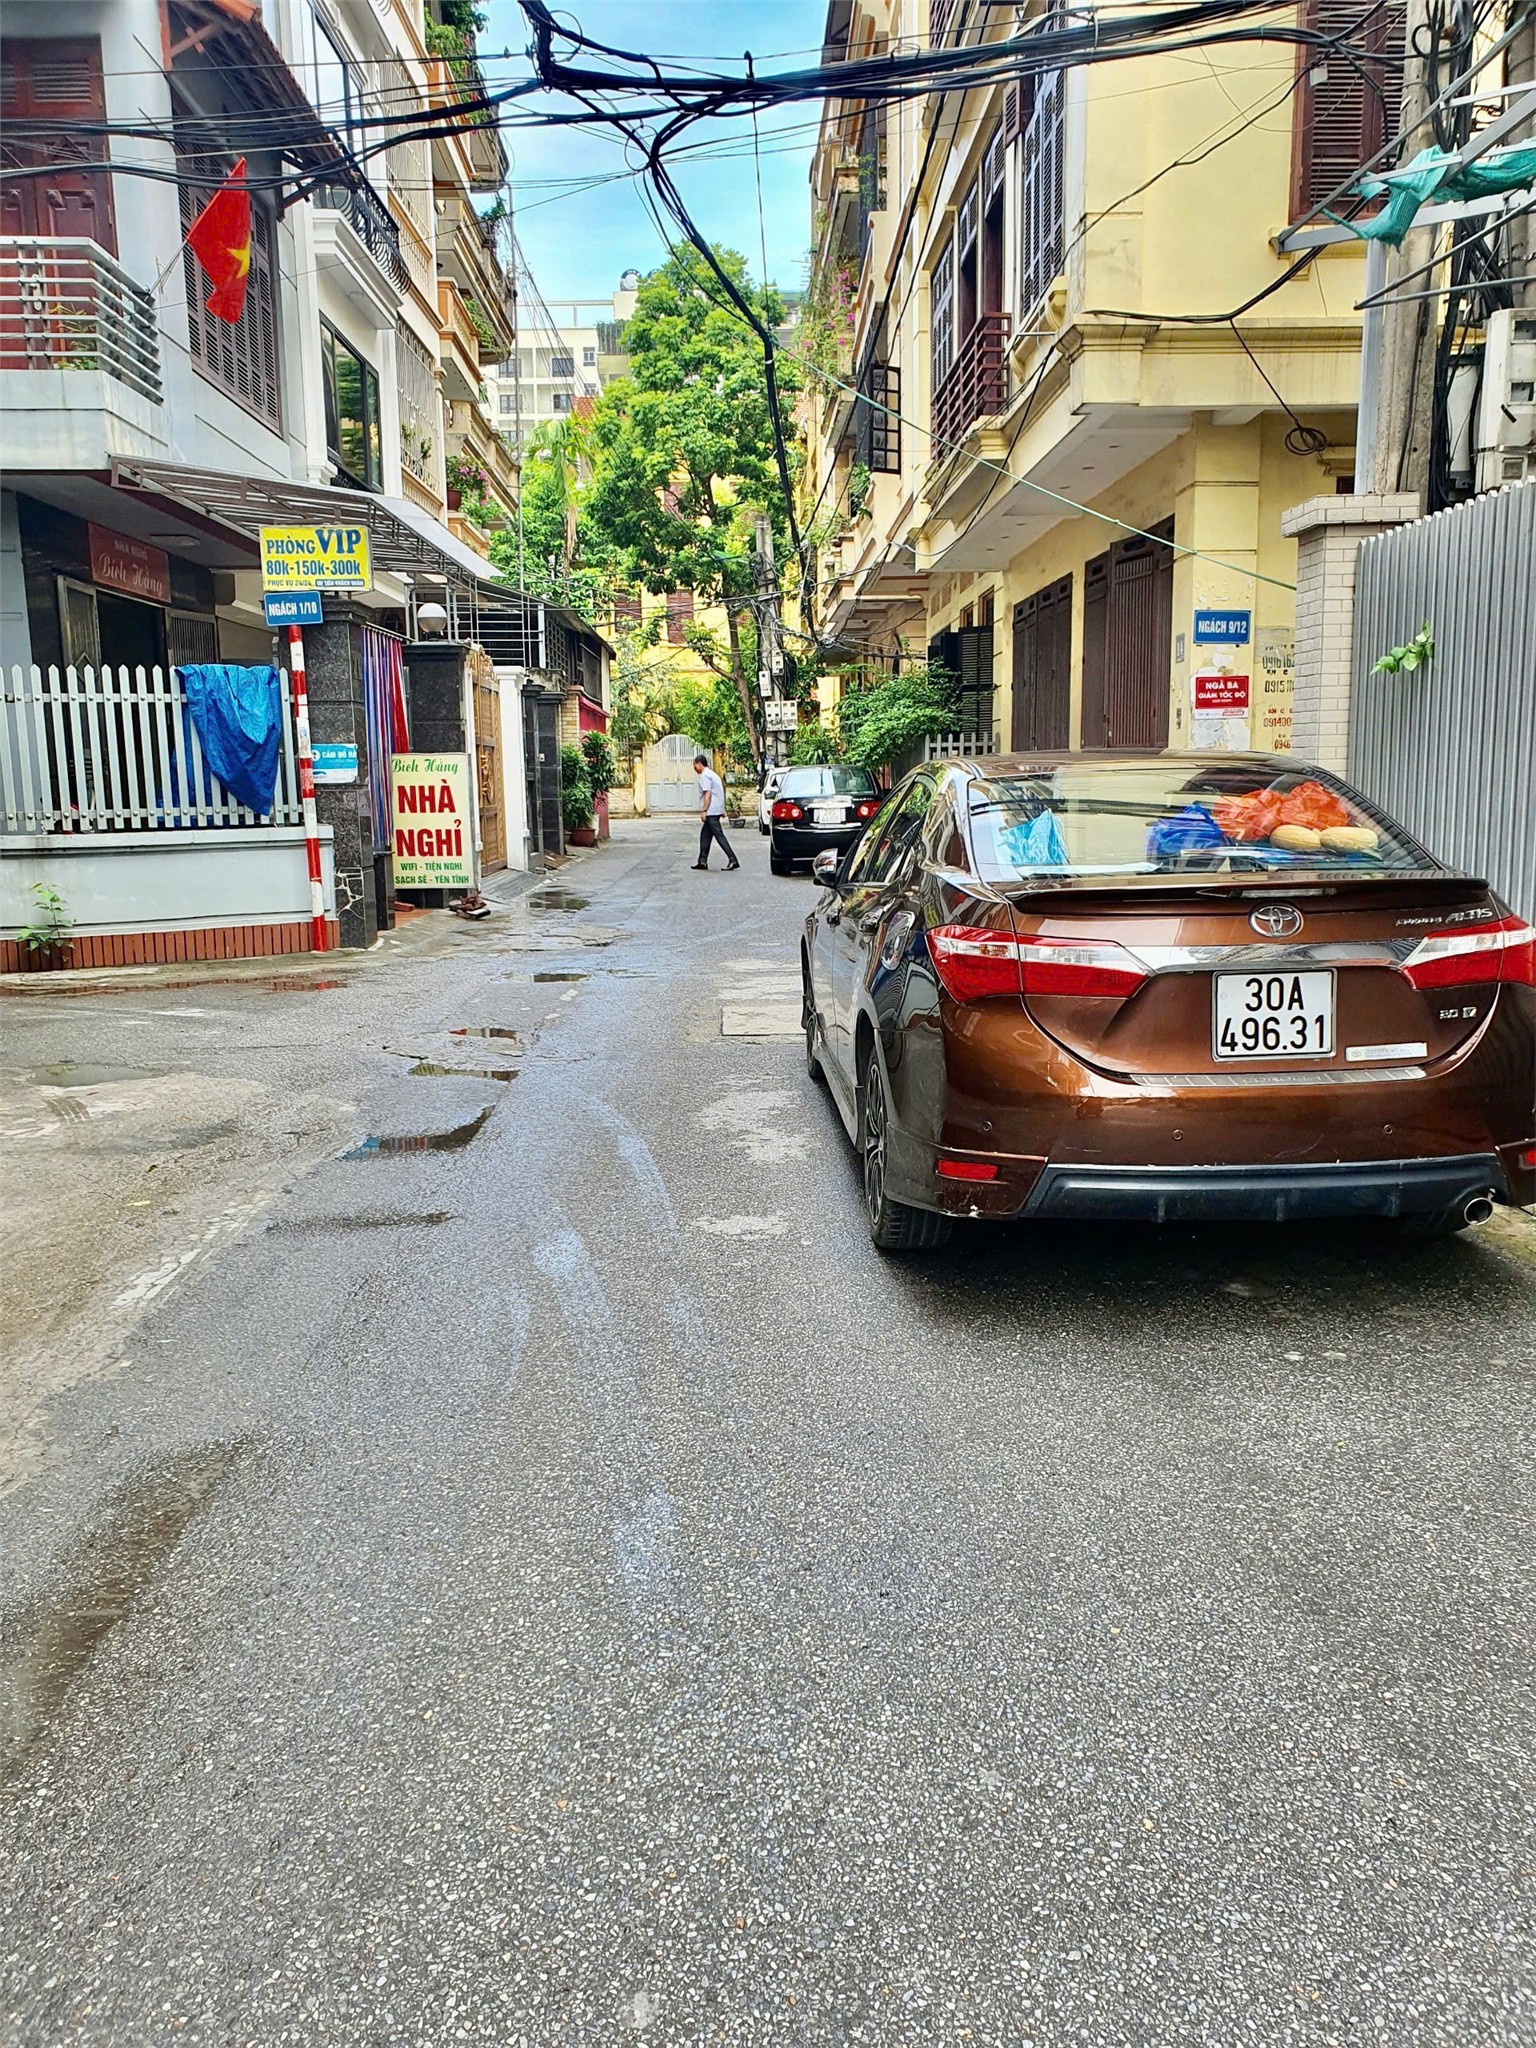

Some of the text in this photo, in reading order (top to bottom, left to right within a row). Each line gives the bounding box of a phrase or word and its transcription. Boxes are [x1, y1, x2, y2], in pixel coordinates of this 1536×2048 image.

[266, 529, 362, 554] PHÒNG VIP
[266, 560, 361, 575] 80k-150k-300k
[267, 580, 284, 588] PHỤC
[268, 601, 318, 616] NGÁCH 1/10
[1198, 617, 1247, 634] NGÁCH 9/12
[1227, 681, 1239, 689] BA
[1219, 690, 1233, 698] TỐC
[1234, 689, 1246, 699] ĐỘ
[397, 779, 456, 813] NHÀ
[395, 819, 463, 857] NGHỈ
[400, 862, 418, 871] WIFI
[425, 860, 442, 872] TIỆN
[444, 862, 462, 871] NGHI
[395, 875, 416, 886] SẠCH
[1445, 908, 1493, 924] ALTIS
[1245, 976, 1305, 1012] 30A
[1220, 1014, 1325, 1051] 496.31
